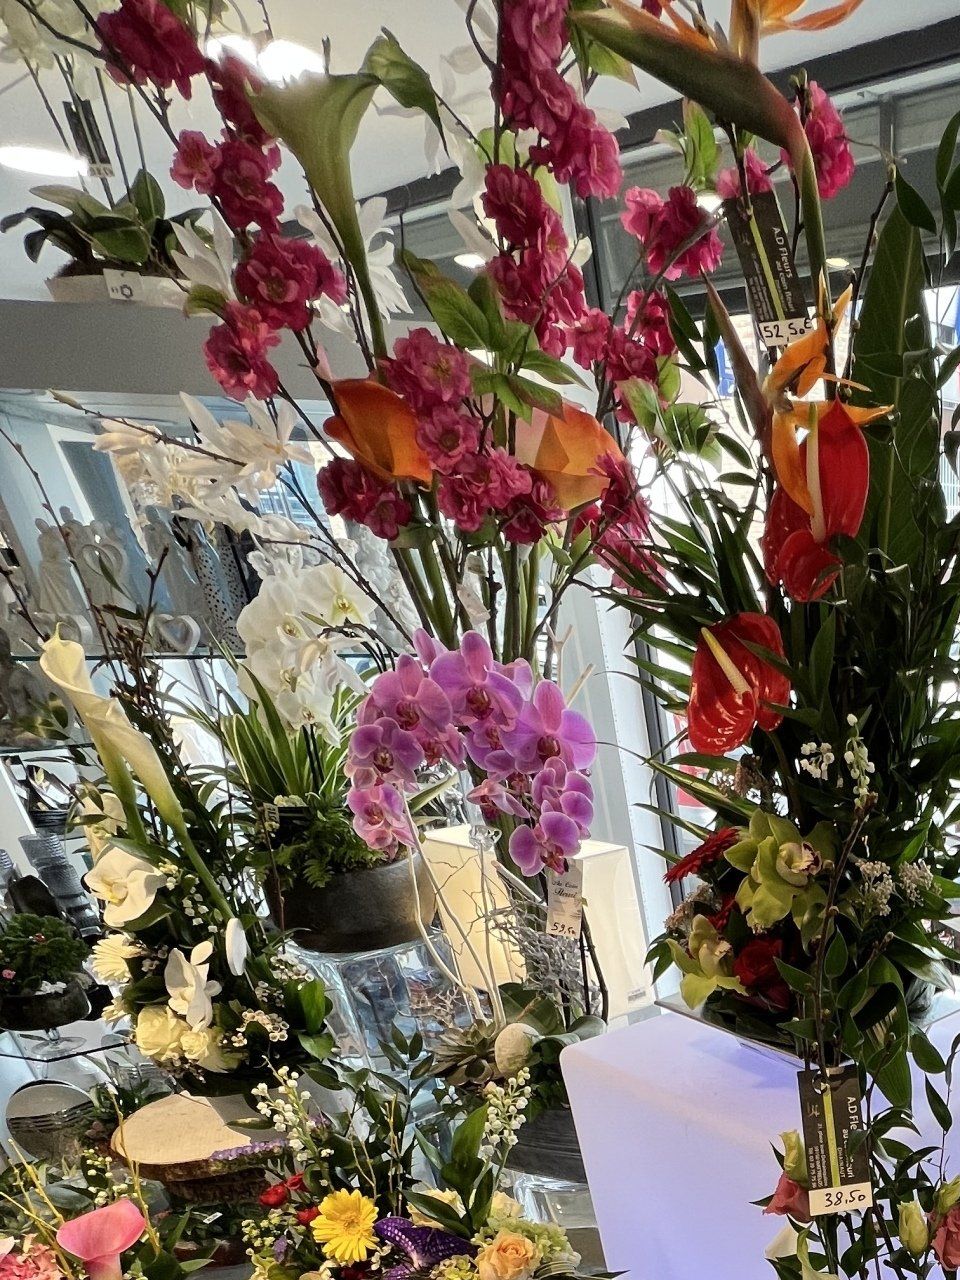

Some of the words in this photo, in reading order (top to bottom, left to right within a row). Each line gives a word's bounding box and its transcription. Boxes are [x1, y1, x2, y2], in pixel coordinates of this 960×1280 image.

[778, 247, 795, 279] Fleurs
[847, 1096, 857, 1114] A.D
[842, 1129, 849, 1139] au
[825, 1190, 866, 1207] 38,50
